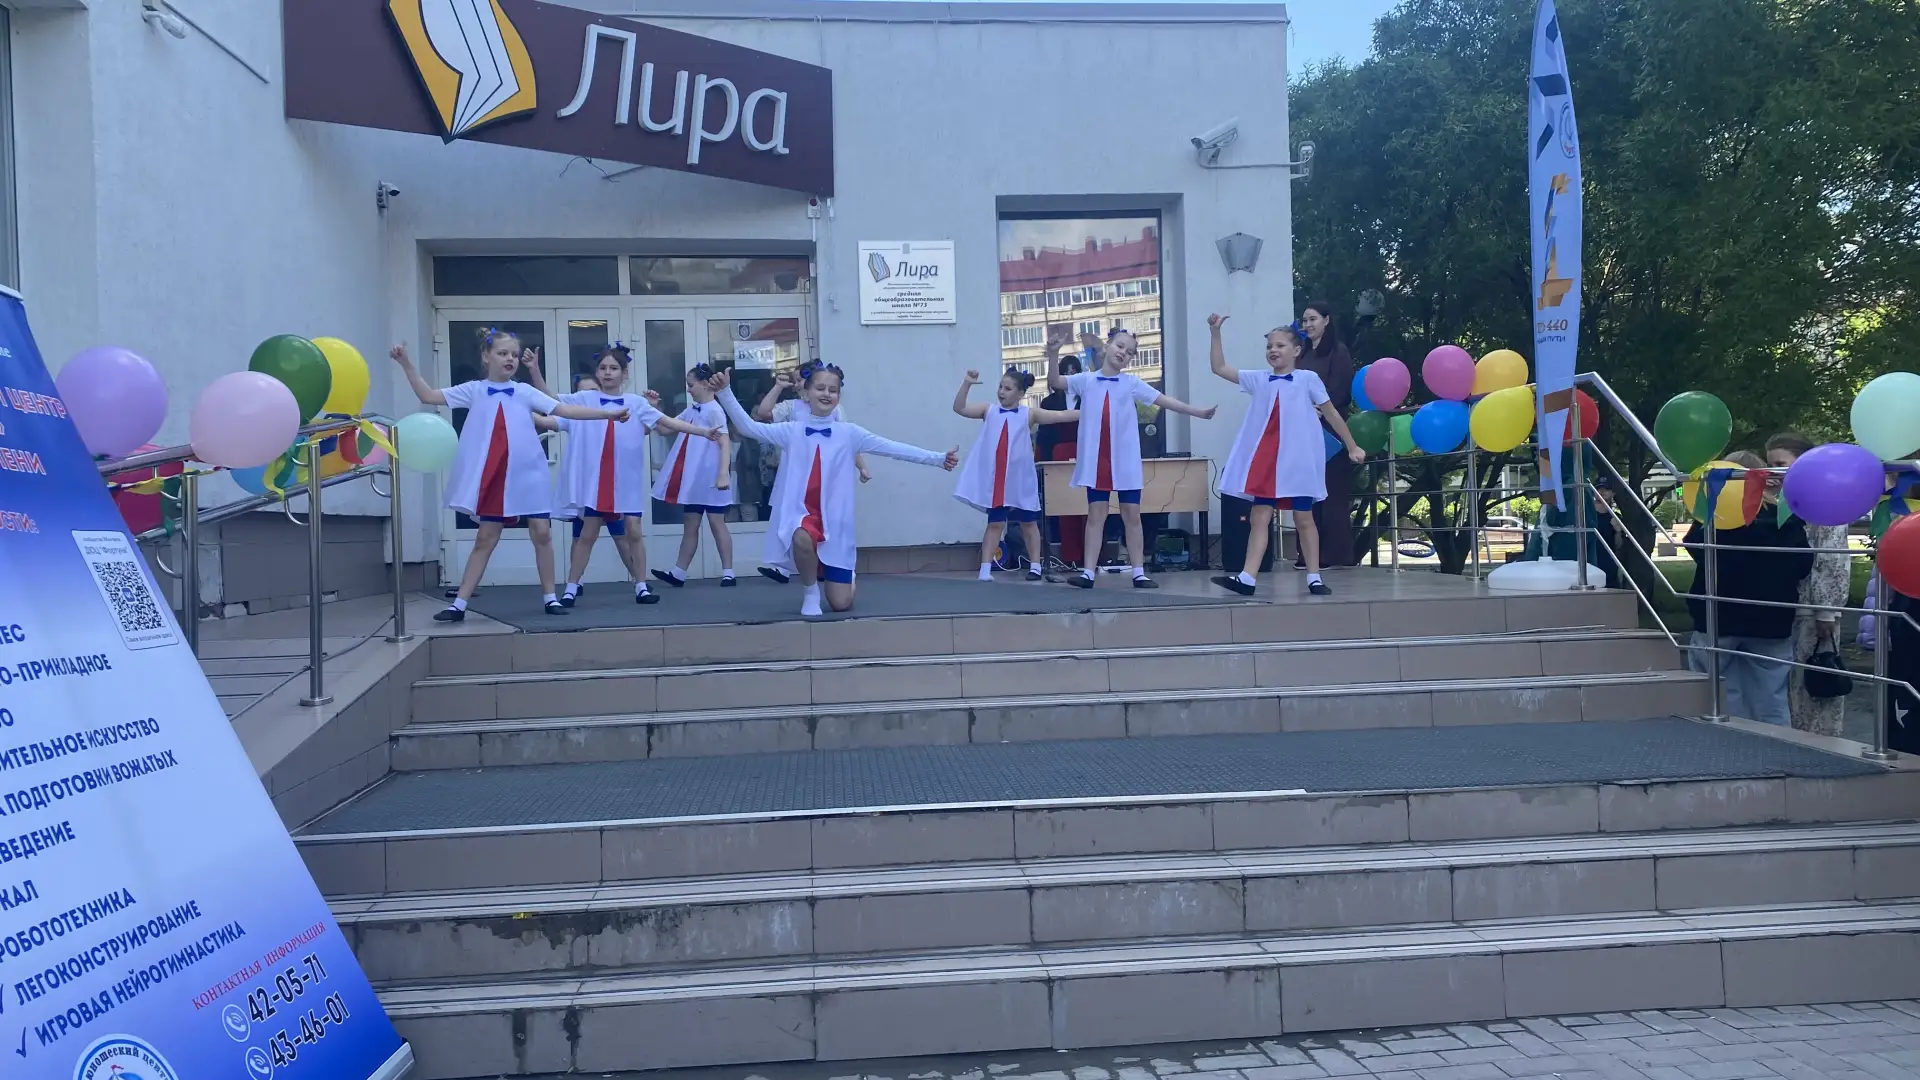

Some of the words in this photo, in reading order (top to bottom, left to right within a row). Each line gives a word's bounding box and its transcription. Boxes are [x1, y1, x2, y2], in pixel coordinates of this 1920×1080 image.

[556, 24, 790, 165] Лира
[895, 261, 939, 280] Лира
[4, 386, 66, 419] ЦЕНТР
[0, 624, 26, 645] ЕС
[0, 653, 113, 686] О-ПРИКЛАДНОЕ
[0, 732, 88, 773] ИТЕЛЬНОЕ
[85, 717, 160, 749] ИСКУССТВО
[4, 766, 114, 810] ПОДГОТОВКИ
[110, 749, 179, 783] ВОЖАТЫХ
[0, 820, 76, 865] ВЕДЕНИЕ
[0, 887, 137, 964] РОБОТОТЕХНИКА
[14, 899, 202, 1006] ЛЕГОКОНСТРУИРОВАНИЕ
[34, 990, 115, 1047] ИГРОВАЯ
[112, 920, 246, 1004] НЕЙРОГИМНАСТИКА
[192, 960, 262, 1011] КОНТАКТНАЯ
[263, 921, 326, 967] ИНФОРМАЦИЯ
[247, 952, 328, 1023] 42-05-71
[269, 991, 350, 1067] 43-46-01
